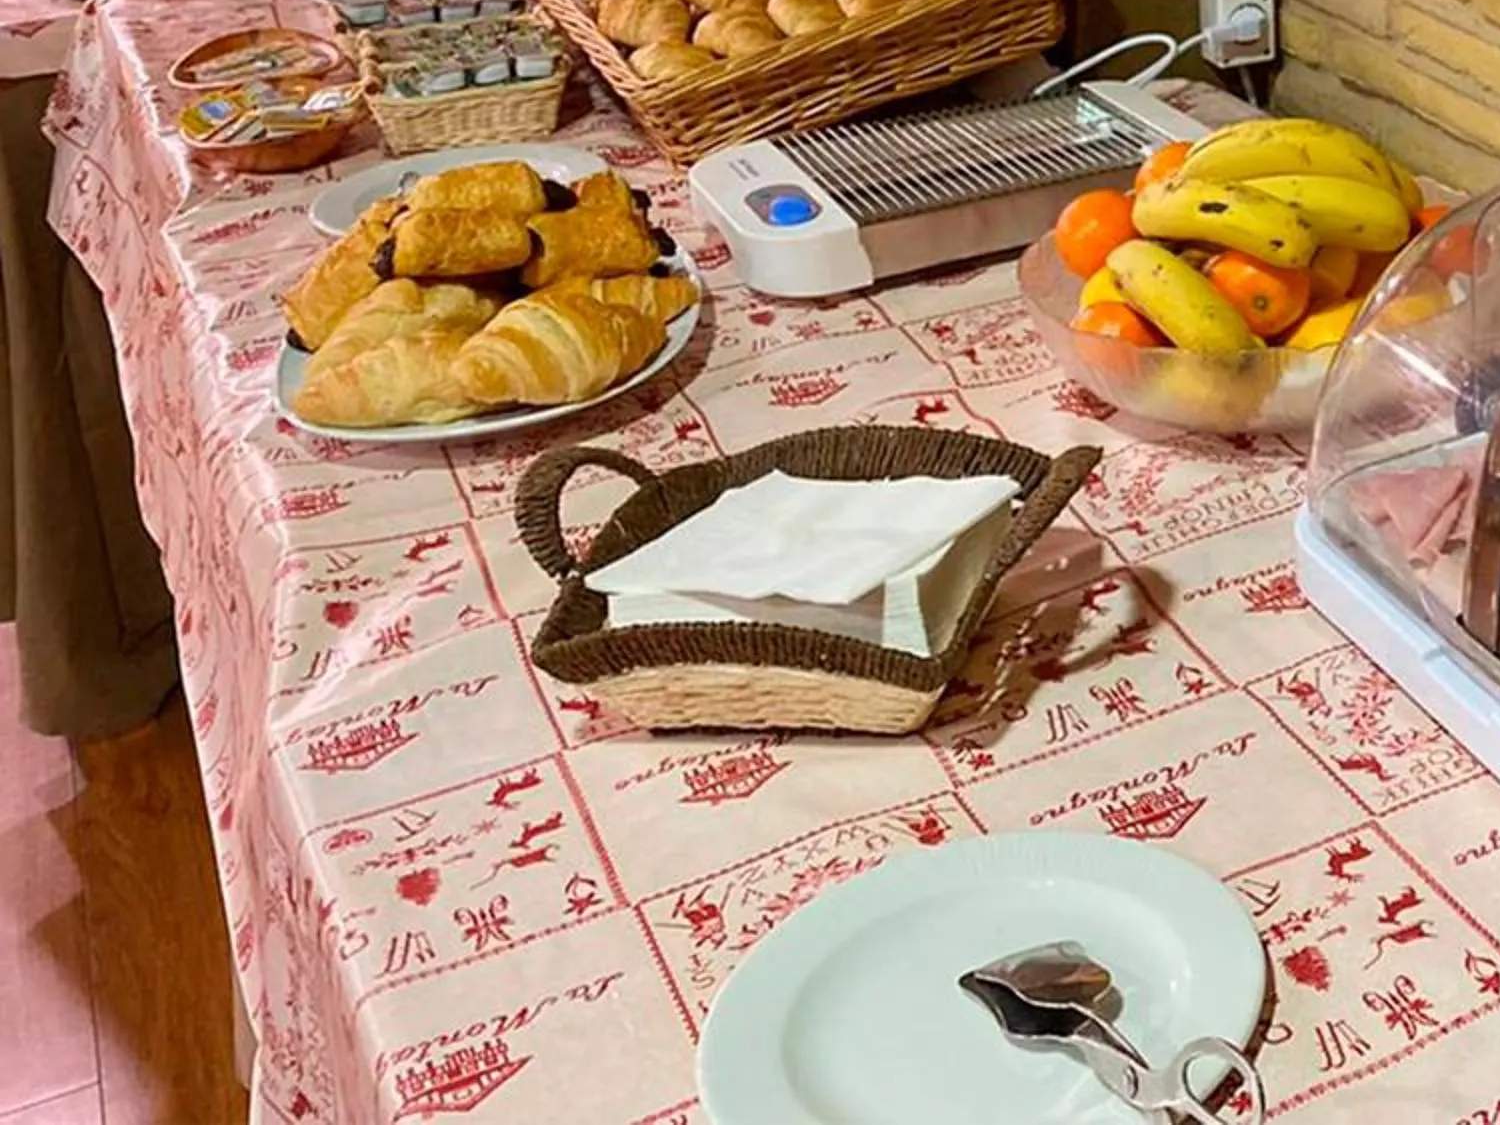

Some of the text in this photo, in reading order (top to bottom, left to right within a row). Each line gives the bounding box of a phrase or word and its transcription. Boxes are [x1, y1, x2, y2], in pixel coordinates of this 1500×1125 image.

[1183, 558, 1297, 602] ontagne
[451, 674, 499, 697] La
[1212, 732, 1257, 757] La
[1030, 751, 1209, 826] Montagne
[375, 971, 625, 1073] La Montag
